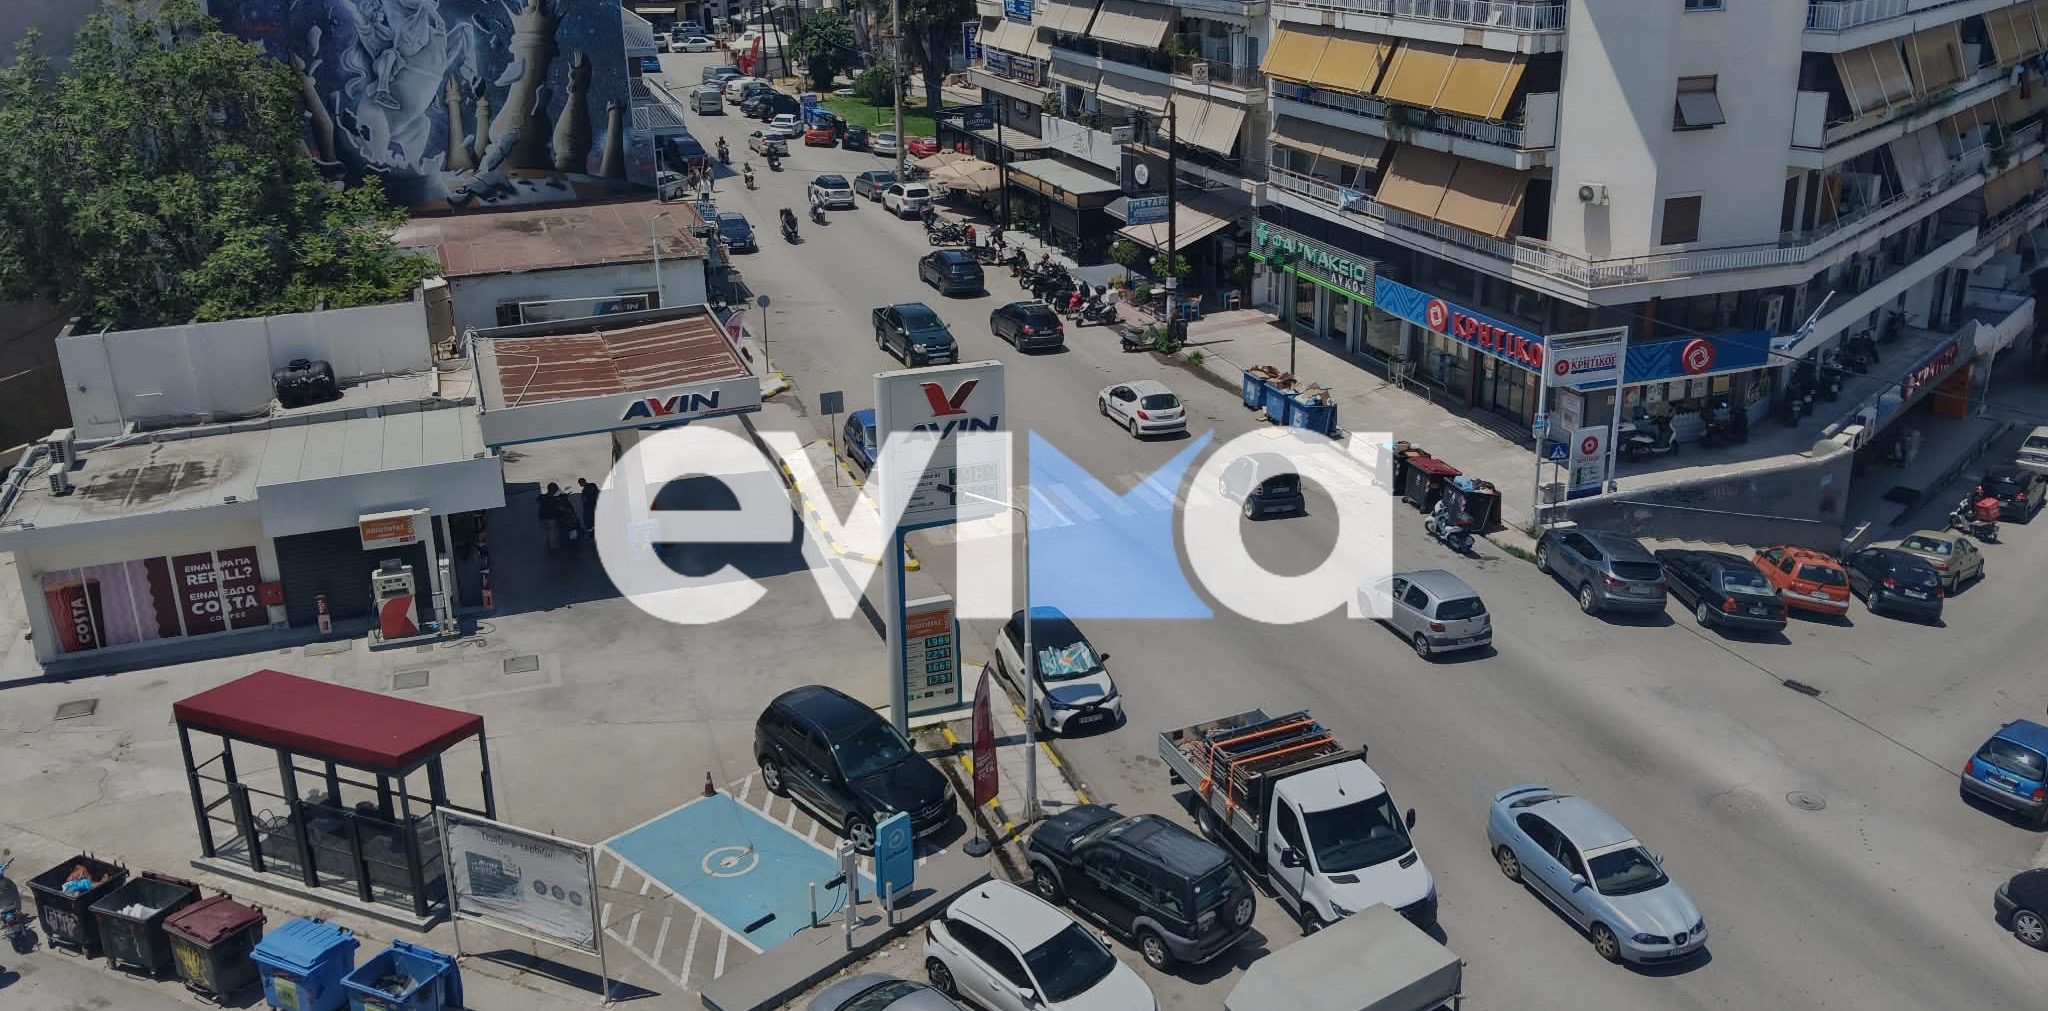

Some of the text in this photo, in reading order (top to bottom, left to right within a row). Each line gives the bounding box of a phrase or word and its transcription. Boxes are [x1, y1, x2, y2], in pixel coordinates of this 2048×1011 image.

[621, 390, 720, 421] AVIN
[903, 414, 999, 444] AVIN
[184, 563, 211, 573] ΕΙΝΑΙ
[190, 590, 219, 601] ΕΙΝΑΙ
[192, 595, 259, 615] COSTA
[71, 598, 90, 643] COSTA
[210, 612, 247, 621] COFEE
